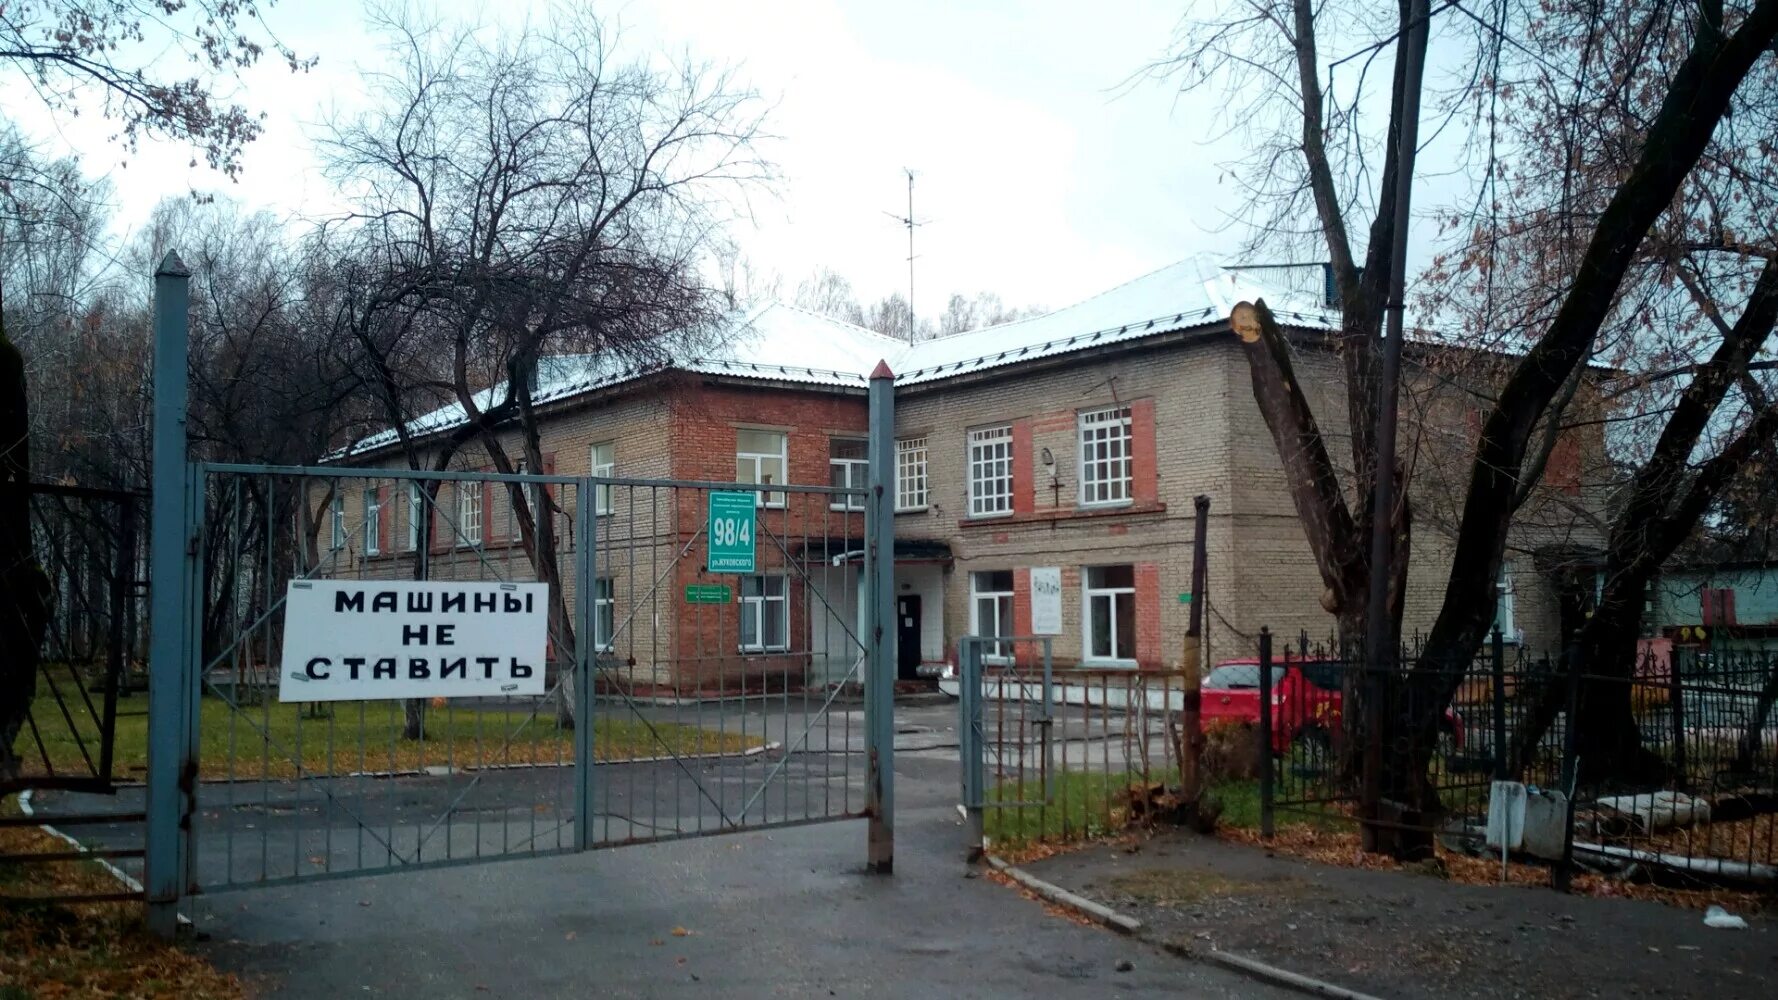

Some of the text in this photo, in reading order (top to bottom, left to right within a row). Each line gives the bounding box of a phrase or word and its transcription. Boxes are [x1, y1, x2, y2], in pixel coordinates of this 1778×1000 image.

[714, 517, 750, 547] 98/4
[334, 590, 534, 614] МАШИНЫ
[402, 624, 456, 646] НЕ
[305, 656, 533, 680] СТАВИТЬ
